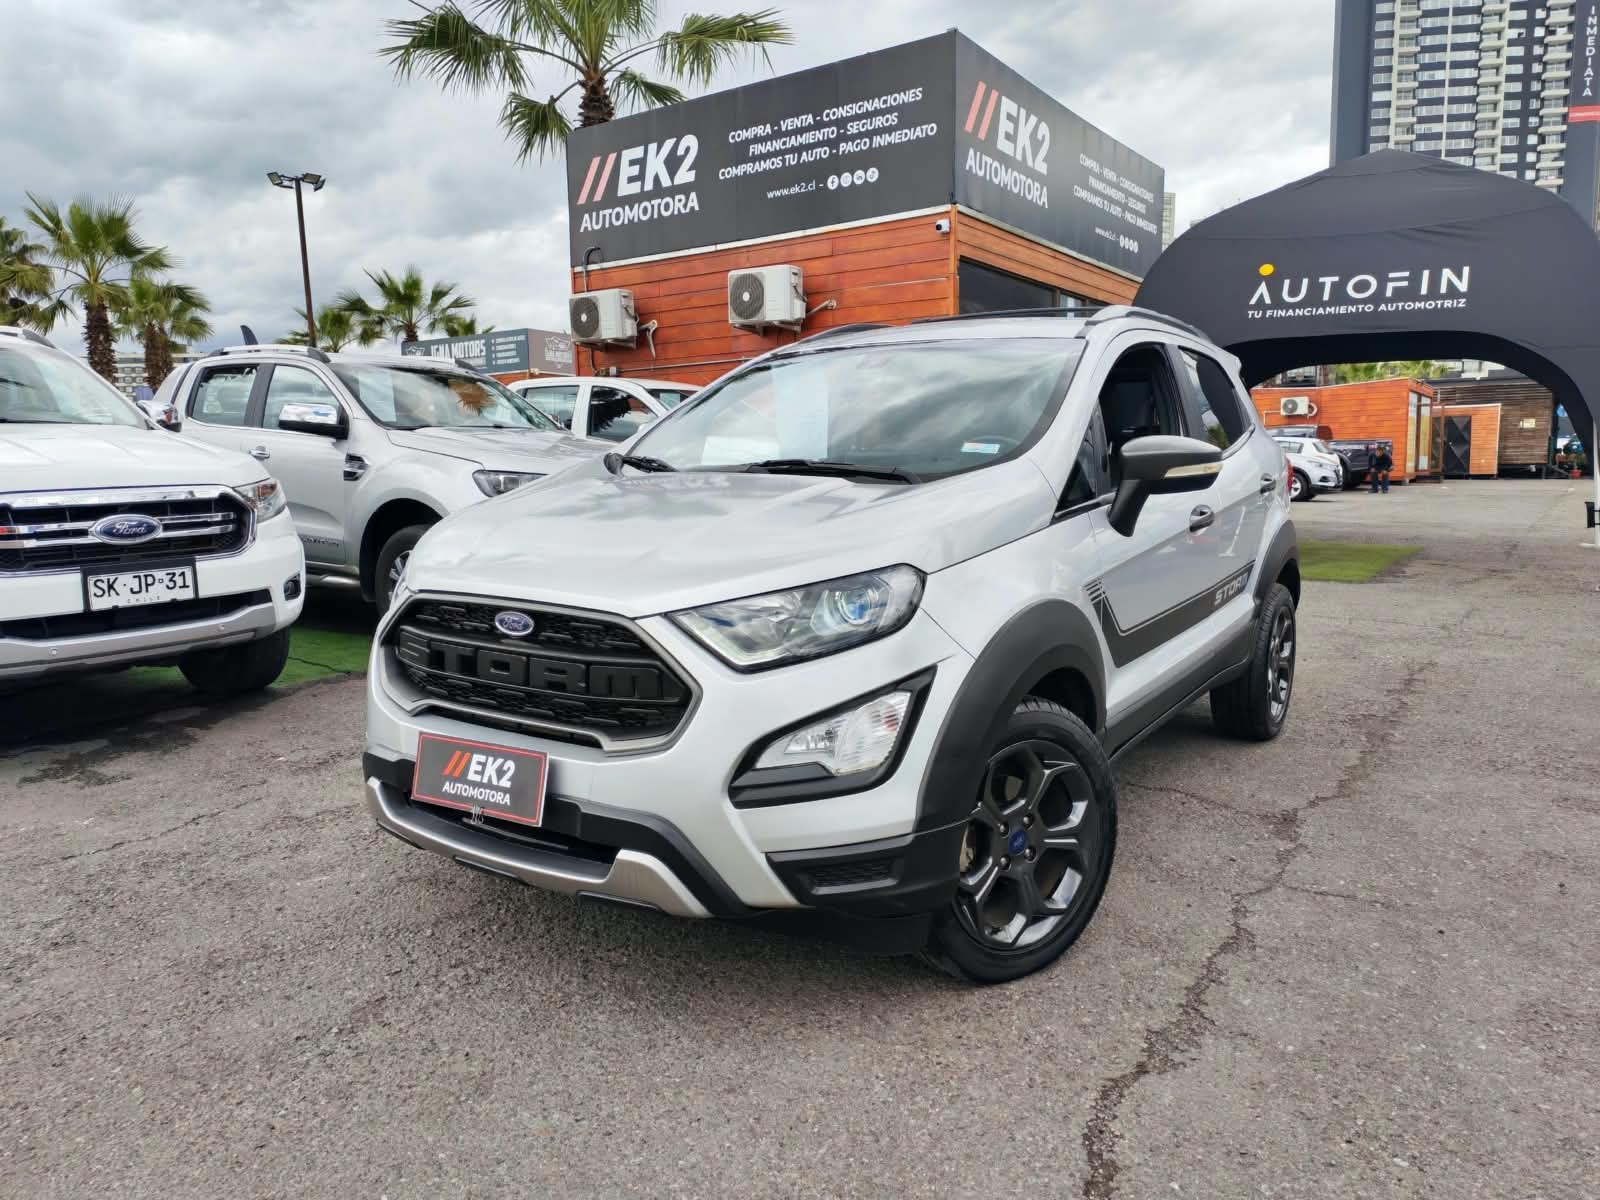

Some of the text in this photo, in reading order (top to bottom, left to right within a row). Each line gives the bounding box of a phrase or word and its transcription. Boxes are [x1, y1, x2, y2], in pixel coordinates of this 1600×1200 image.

[1582, 5, 1598, 97] INMEDIATA
[728, 123, 772, 144] COMPRA
[780, 113, 814, 132] VENTA
[823, 87, 923, 122] CONSIGNACIONES
[749, 126, 837, 157] FINANCIAMIENTO
[846, 112, 899, 136] SEGUROS
[719, 155, 783, 180] COMPRAMOS
[785, 152, 798, 167] TU
[800, 146, 830, 163] AUTO
[838, 137, 870, 156] PAGO
[872, 122, 938, 149] INMEDIATO
[767, 179, 816, 199] www.ek2.cl
[966, 147, 1049, 209] AUTOMOTORA
[579, 191, 700, 233] AUTOMOTORA
[1248, 264, 1471, 305] AUTOFIN
[1247, 298, 1467, 319] TU FINANCIAMIENTO AUTOMOTRIZ
[397, 629, 672, 699] STORM
[442, 780, 512, 806] AUTOMOTORA
